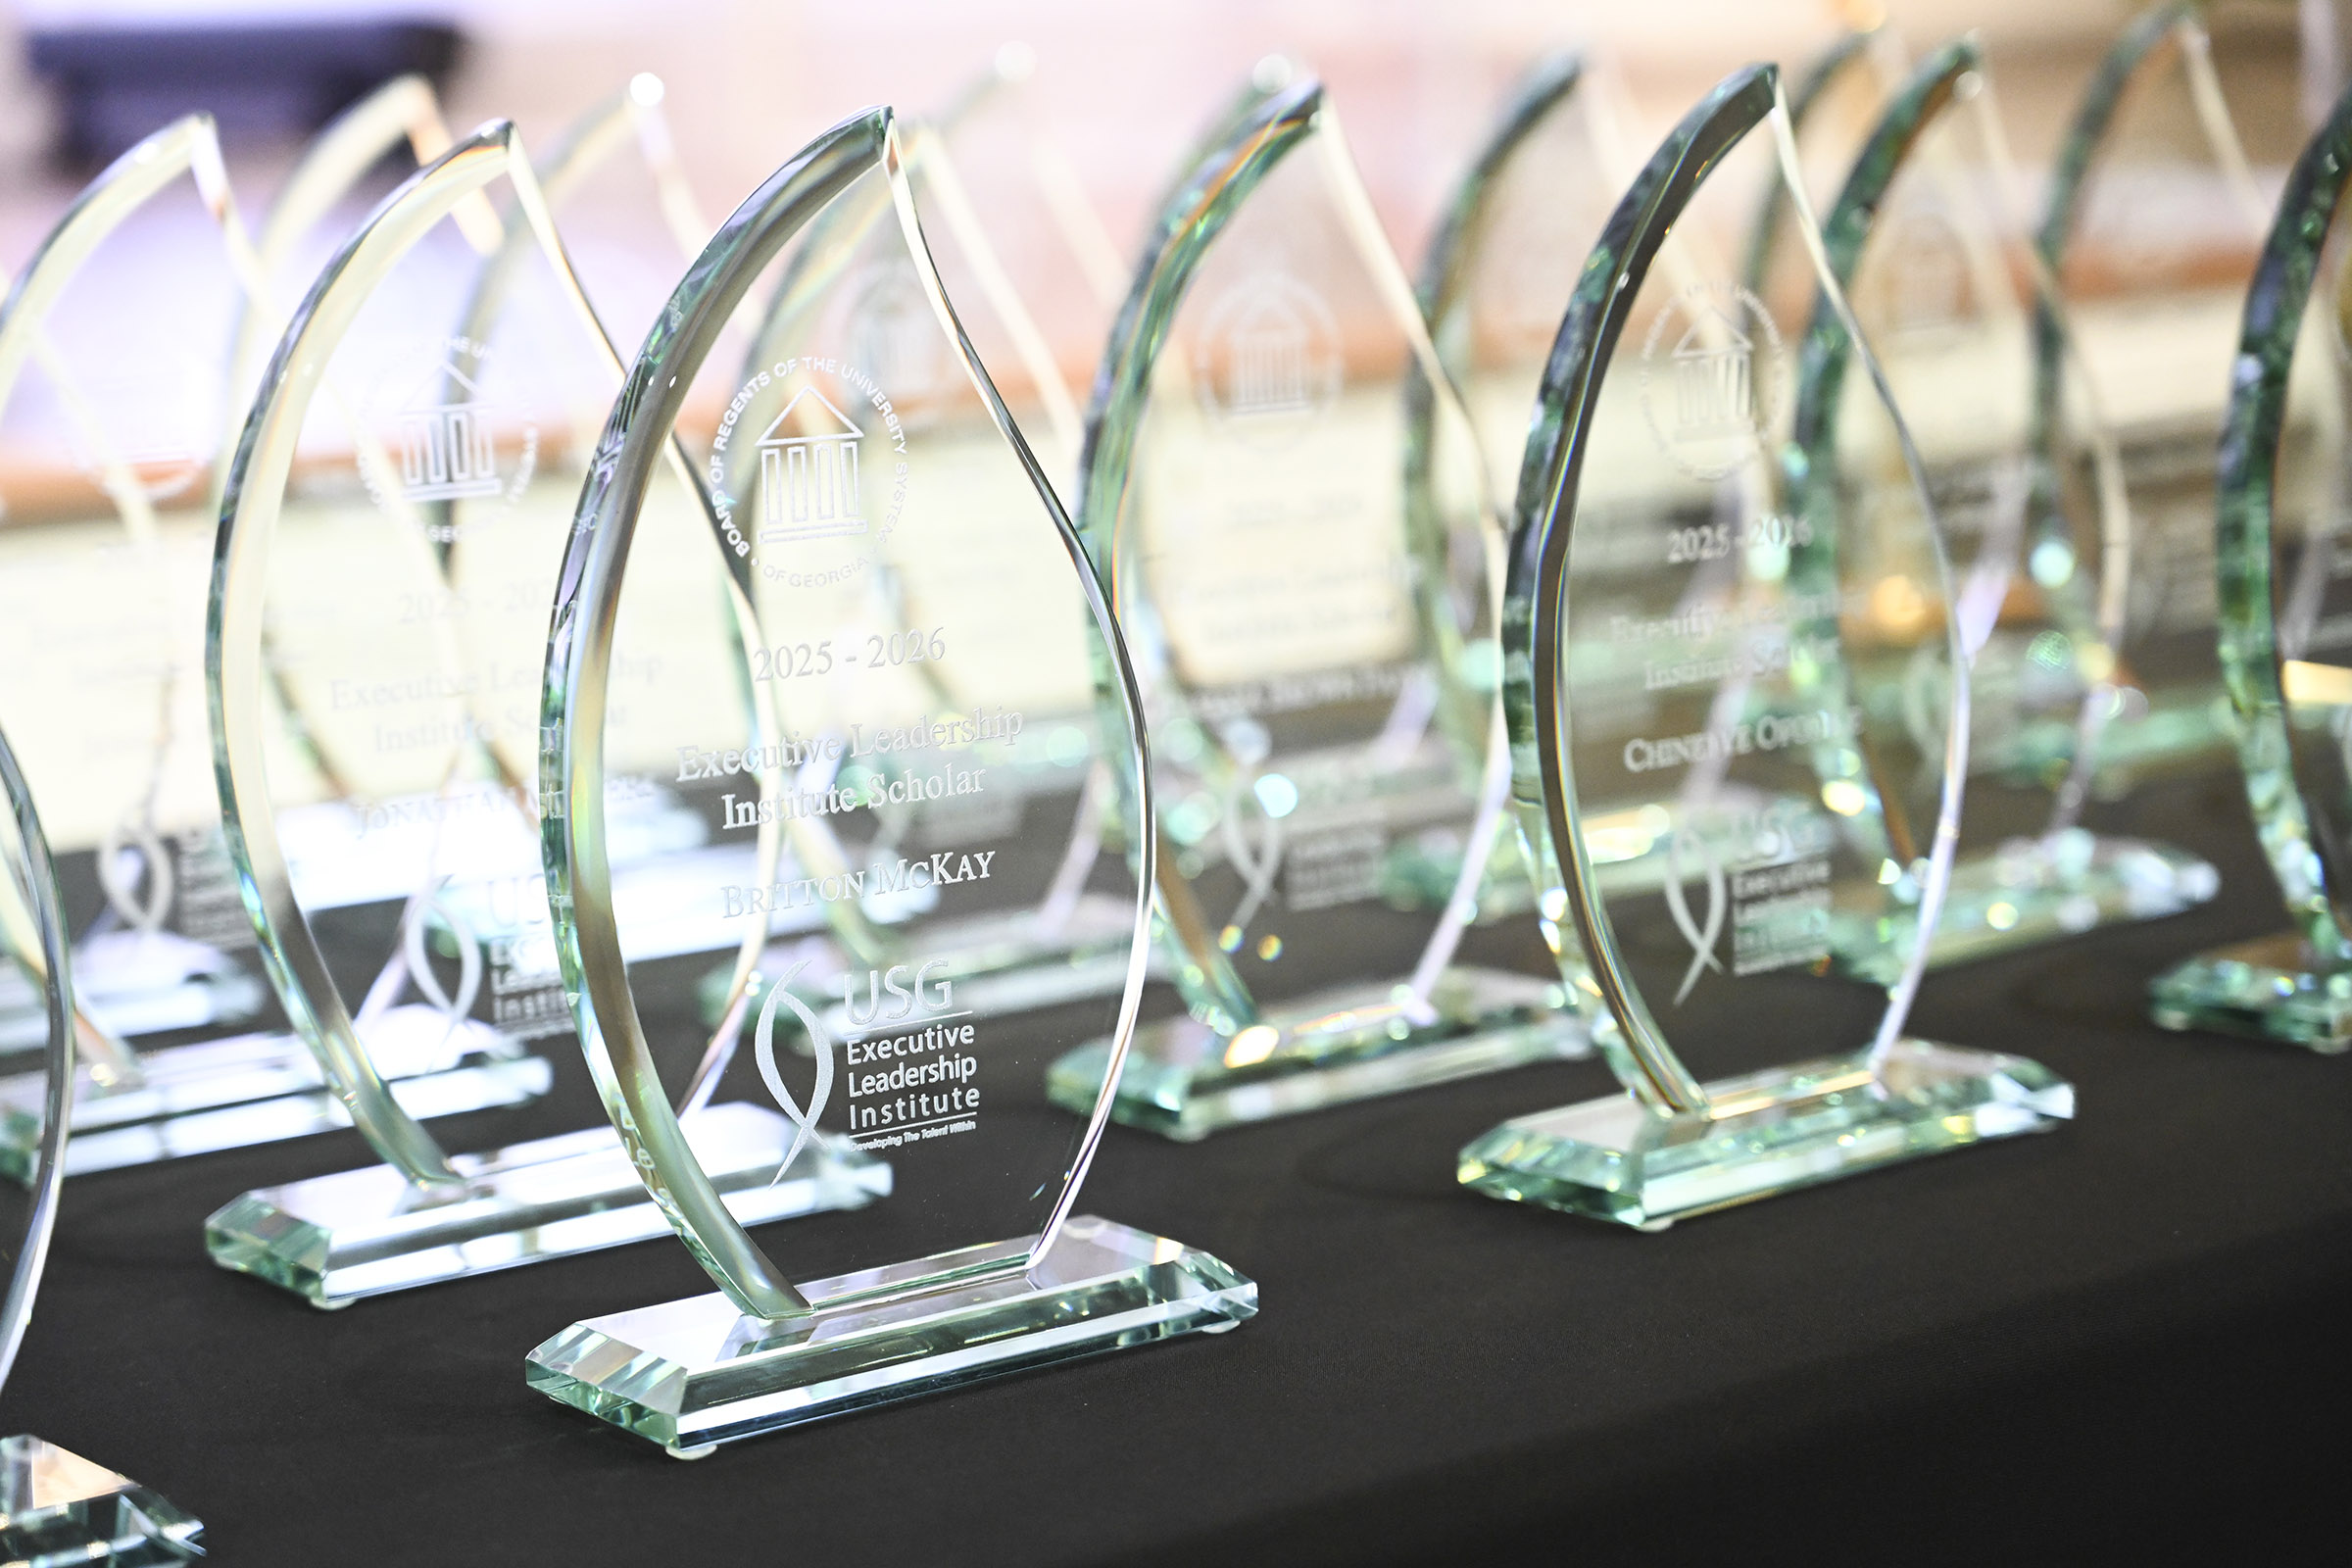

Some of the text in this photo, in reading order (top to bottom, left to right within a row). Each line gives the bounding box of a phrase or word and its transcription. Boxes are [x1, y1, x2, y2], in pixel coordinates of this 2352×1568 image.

[710, 356, 909, 558] BOARD OF REGENTS OF THE UNIVERSITY SYSTEM
[762, 556, 870, 589] OF GEORGIA
[753, 641, 833, 683] 2025
[866, 626, 947, 670] 2026
[675, 705, 1024, 783] Executive Leadership
[721, 762, 988, 830] Institute Scholar
[720, 869, 866, 919] BRITTON
[843, 957, 954, 1026] USG
[847, 1023, 975, 1066] Executive
[848, 1052, 978, 1099] Leadership
[850, 1087, 981, 1130] Institute
[850, 1119, 977, 1152] Developing The Talent Within
